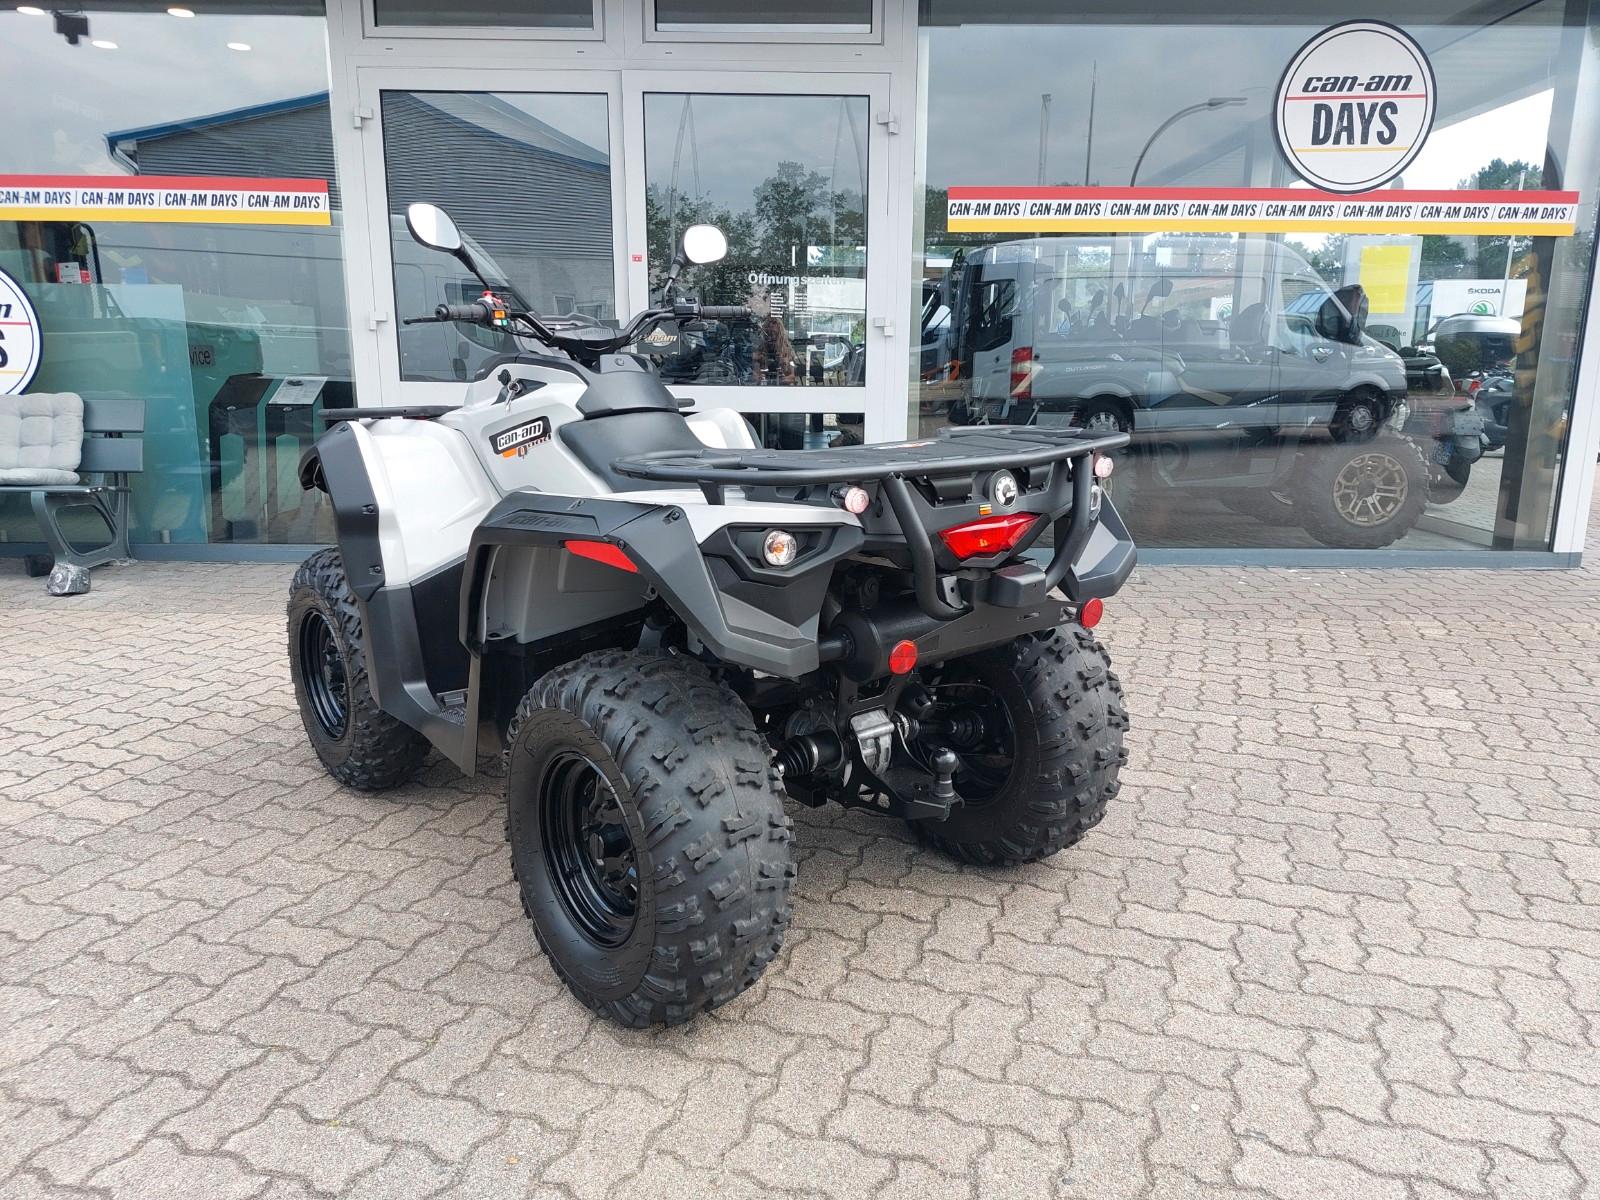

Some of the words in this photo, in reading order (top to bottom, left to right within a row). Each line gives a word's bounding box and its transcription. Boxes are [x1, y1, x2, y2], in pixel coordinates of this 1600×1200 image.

[1302, 75, 1412, 92] can-am
[1312, 102, 1398, 145] DAYS
[44, 192, 71, 204] DAYS
[82, 192, 123, 205] CAN-AM
[128, 192, 154, 206] DAYS
[165, 193, 207, 206] CAN-AM
[211, 193, 237, 207] DAYS
[248, 194, 290, 208] CAN-AM
[294, 195, 320, 209] DAYS
[950, 203, 991, 215] CAN-AM
[994, 203, 1020, 215] DAYS
[1030, 203, 1072, 215] CAN-AM
[1075, 203, 1101, 215] DAYS
[1111, 204, 1151, 215] CAN-AM
[1154, 204, 1179, 215] DAYS
[1188, 204, 1228, 216] CAN-AM
[1231, 204, 1257, 216] DAYS
[1266, 205, 1306, 216] CAN-AM
[1309, 205, 1334, 216] DAYS
[1344, 206, 1383, 217] CAN-AM
[1386, 206, 1412, 217] DAYS
[1421, 207, 1461, 218] CAN-AM
[1464, 207, 1489, 218] DAYS
[1498, 208, 1539, 219] CAN-AM
[1541, 208, 1567, 219] DAYS
[498, 423, 542, 448] can-am
